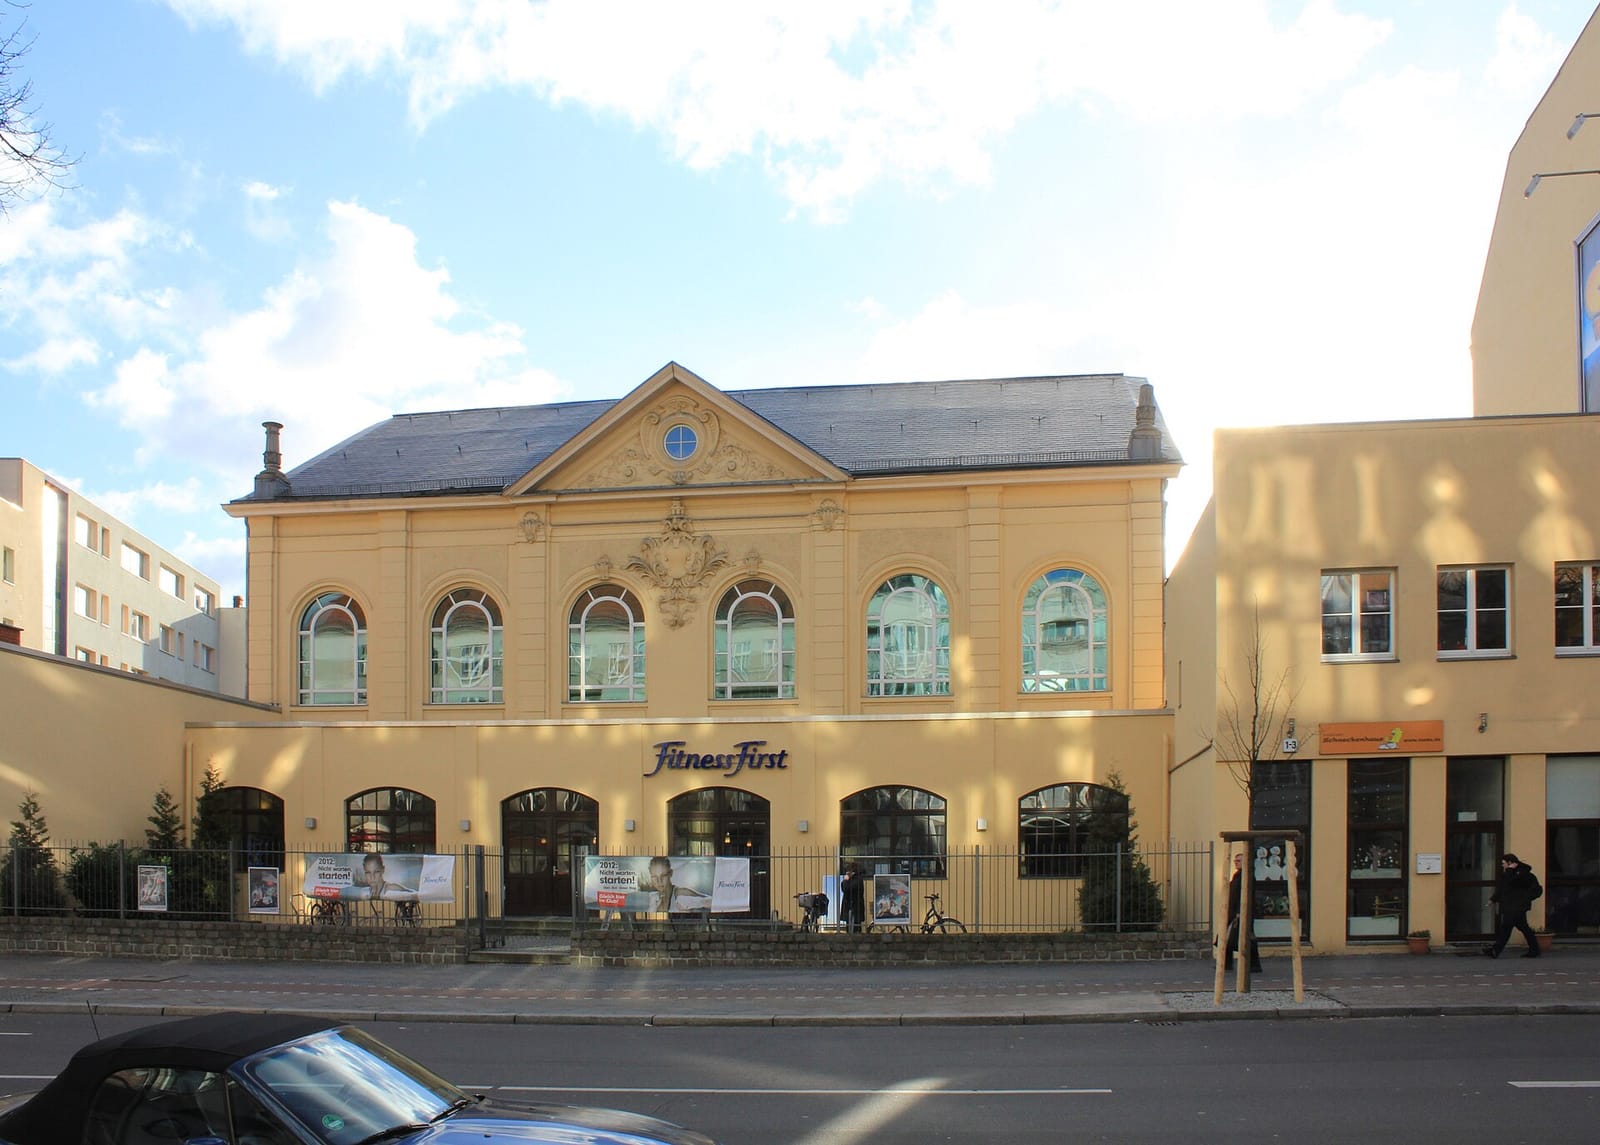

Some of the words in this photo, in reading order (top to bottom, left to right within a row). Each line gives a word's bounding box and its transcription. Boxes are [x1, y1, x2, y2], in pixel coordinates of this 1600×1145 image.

[1285, 741, 1297, 749] 1-3
[318, 872, 351, 880] starten!
[600, 876, 635, 884] starten!
